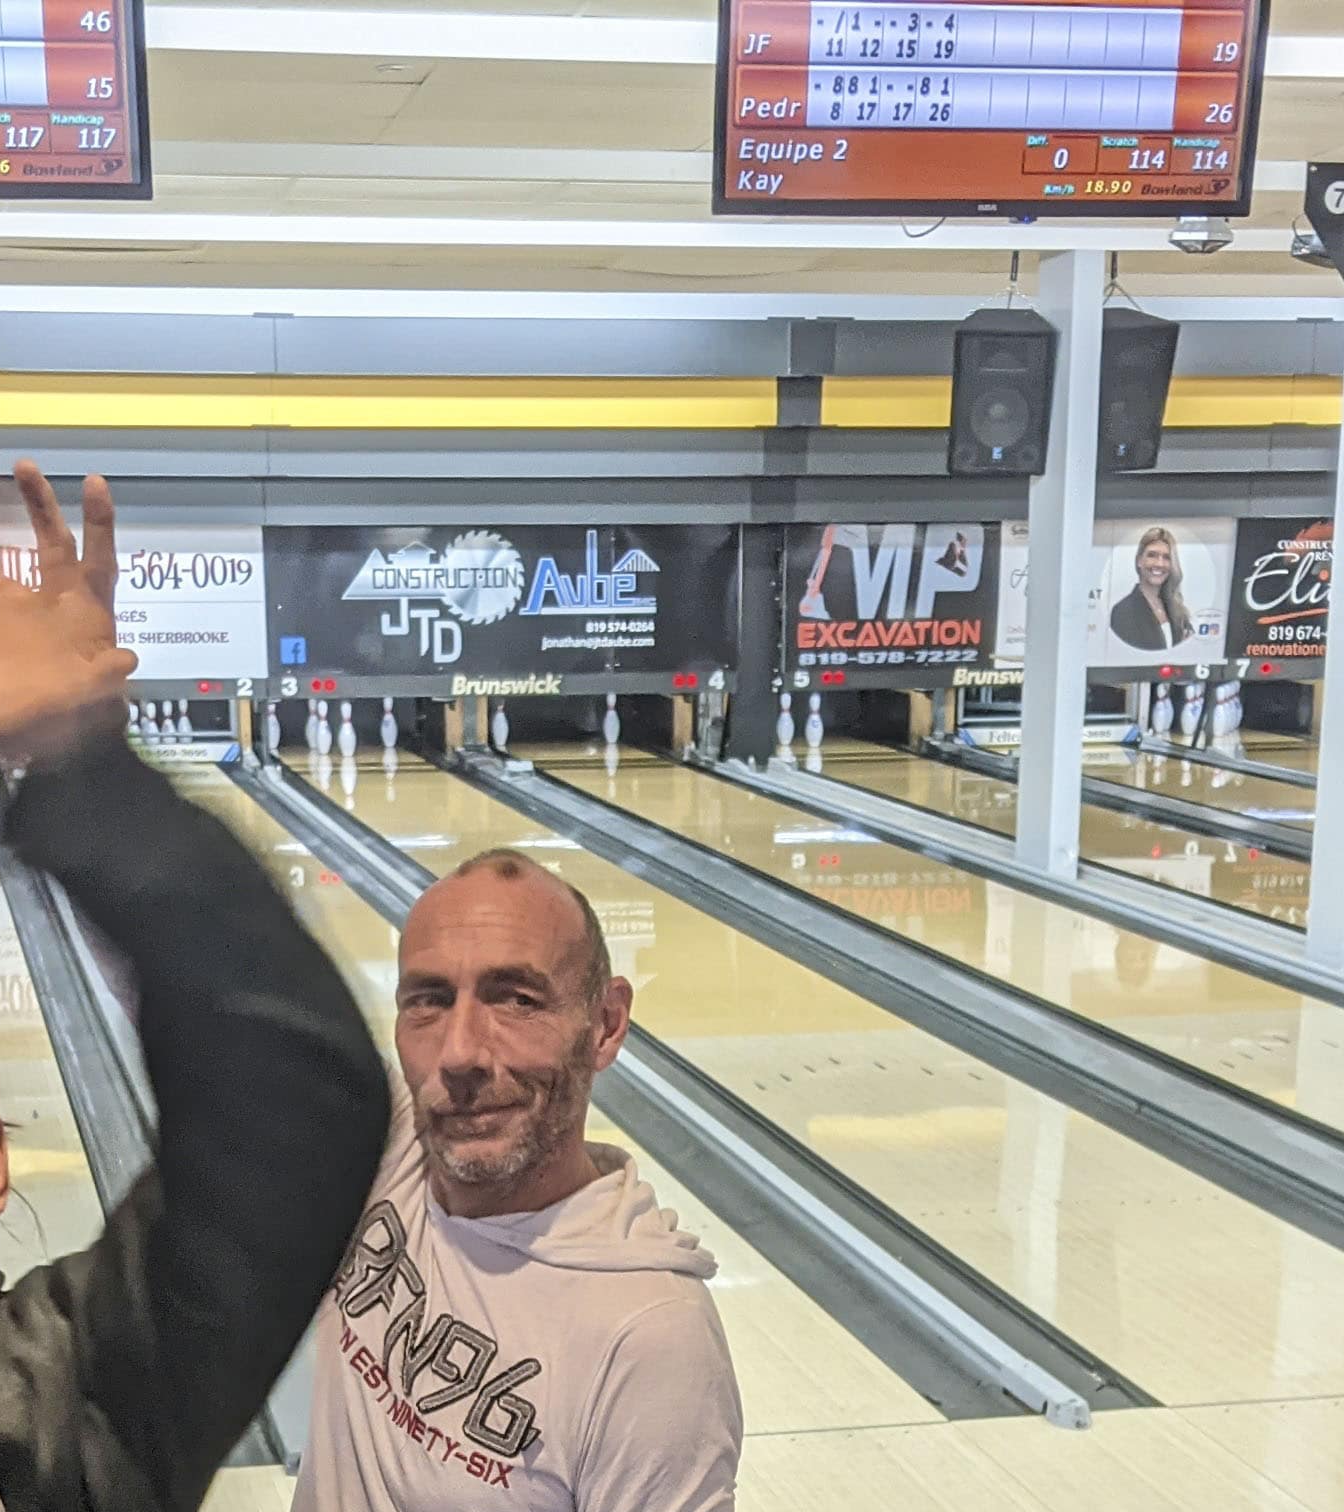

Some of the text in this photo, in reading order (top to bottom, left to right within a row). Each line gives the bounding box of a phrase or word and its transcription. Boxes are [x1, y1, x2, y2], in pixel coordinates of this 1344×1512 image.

[80, 10, 111, 32] 46
[744, 33, 1238, 62] JF 11 12 15 19 19
[86, 77, 113, 98] 15
[740, 98, 1233, 123] Pedr 8 17 17 26 26
[5, 126, 44, 148] 117
[77, 128, 116, 149] 117
[739, 139, 848, 164] Equipe 2
[1054, 148, 1228, 170] 0 114 114
[737, 170, 784, 195] Kay
[1084, 180, 1132, 194] 18.90
[372, 567, 517, 590] CONSTRUCTION
[832, 523, 985, 620] VIP
[138, 632, 230, 644] SHERBROOKE
[381, 597, 462, 663] JTD
[585, 621, 607, 633] 819
[797, 620, 982, 649] EXCAVATION
[1268, 626, 1293, 641] 819
[237, 678, 254, 697] 2
[281, 677, 298, 696] 3
[452, 672, 561, 697] Brunswick
[708, 669, 726, 690] 4
[794, 670, 809, 688] 5
[1195, 662, 1210, 679] 6
[1236, 658, 1250, 678] 7
[387, 1403, 515, 1490] NINETY-SIX
